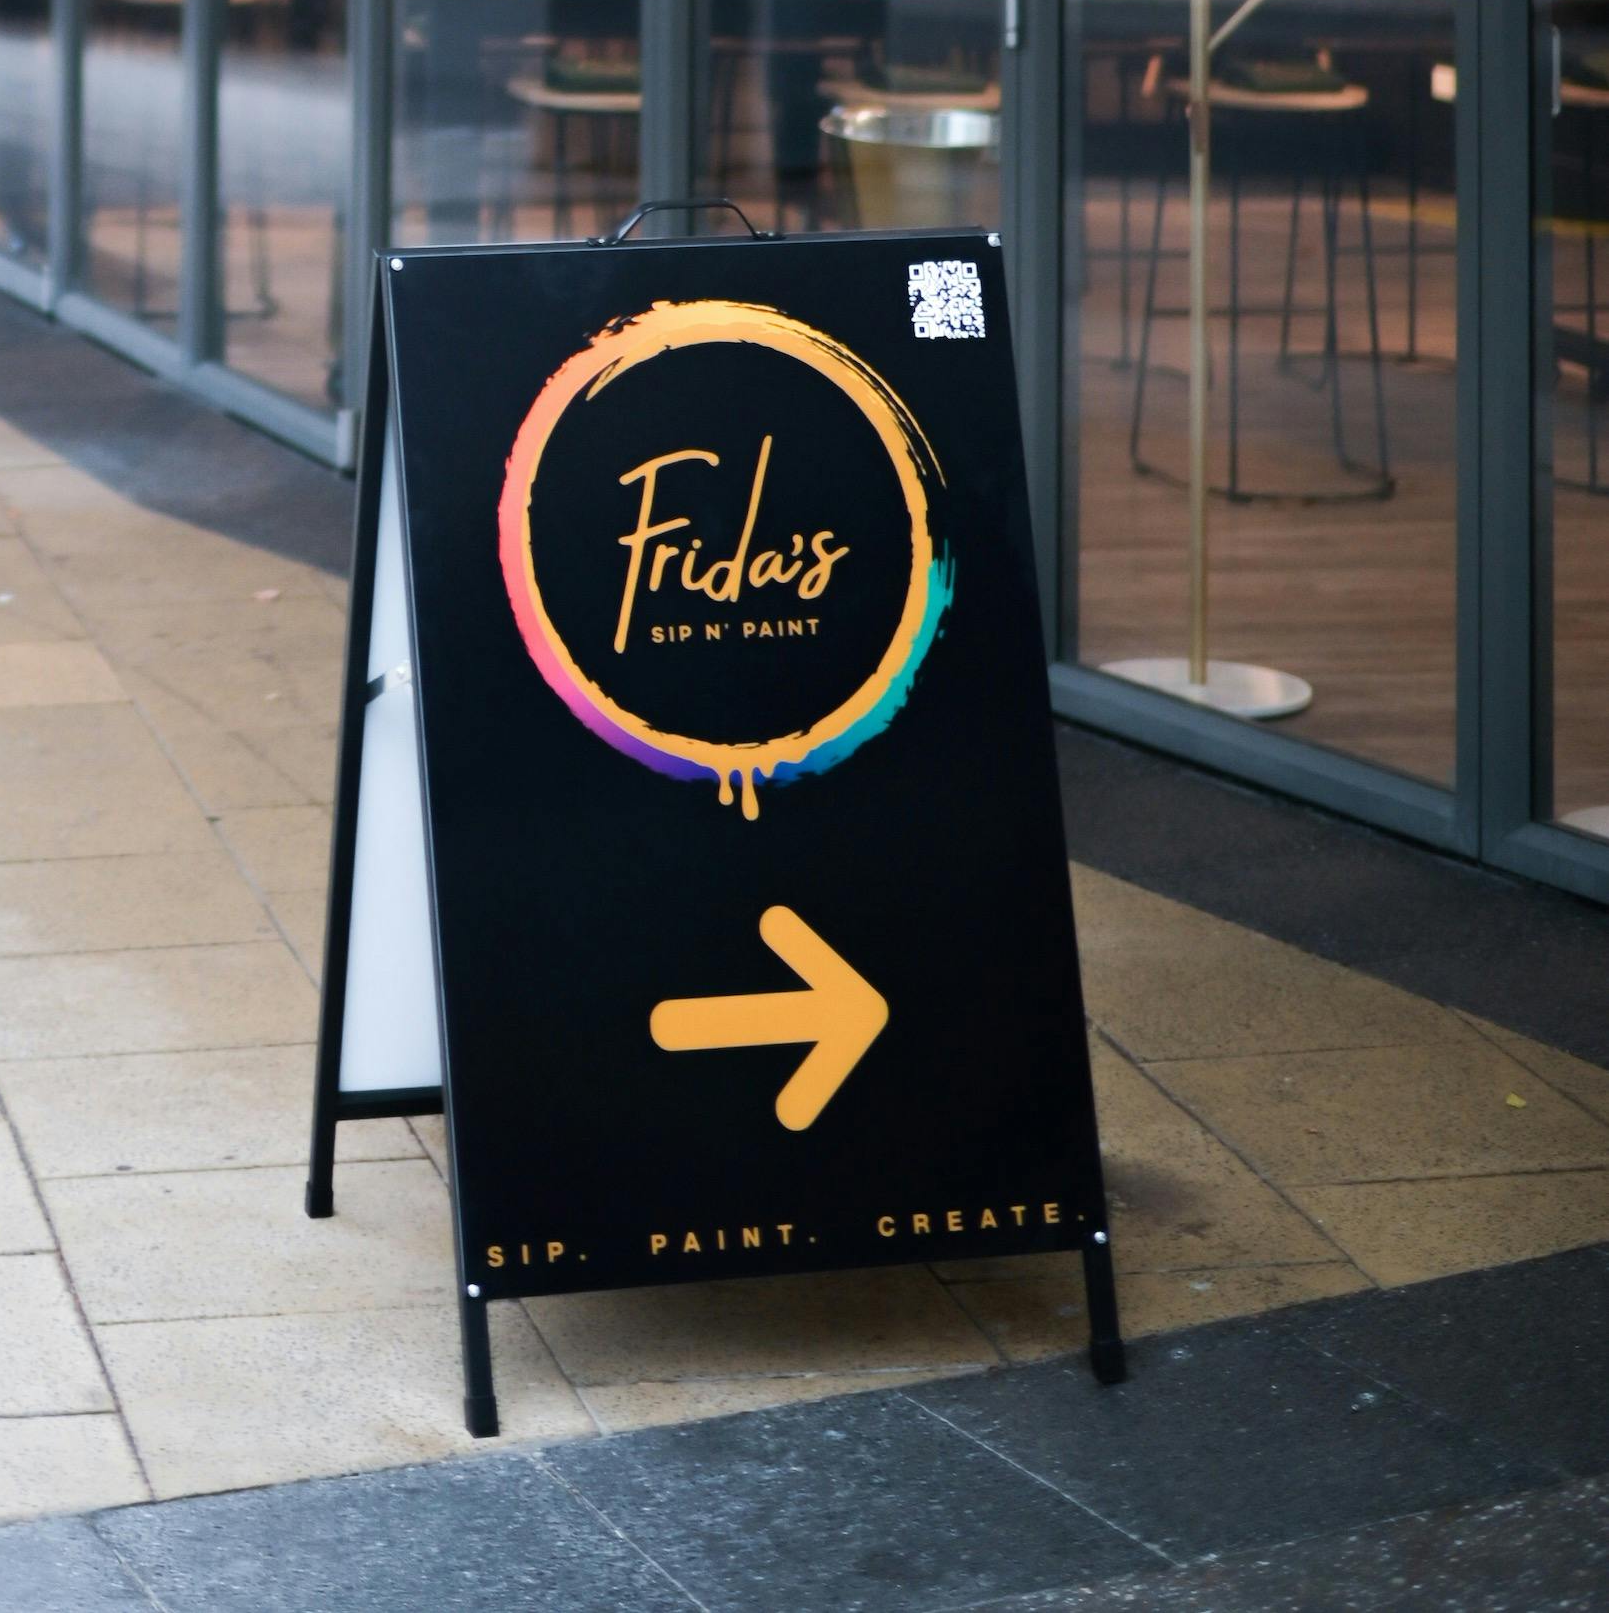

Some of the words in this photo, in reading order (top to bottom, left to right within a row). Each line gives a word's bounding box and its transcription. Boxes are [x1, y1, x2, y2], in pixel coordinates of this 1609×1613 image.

[613, 434, 850, 654] Frida's
[651, 625, 693, 643] SIP
[742, 618, 820, 638] PAINT
[487, 1240, 588, 1268] SIP.
[650, 1223, 817, 1255] PAINT.
[876, 1202, 1086, 1238] CREATE.
